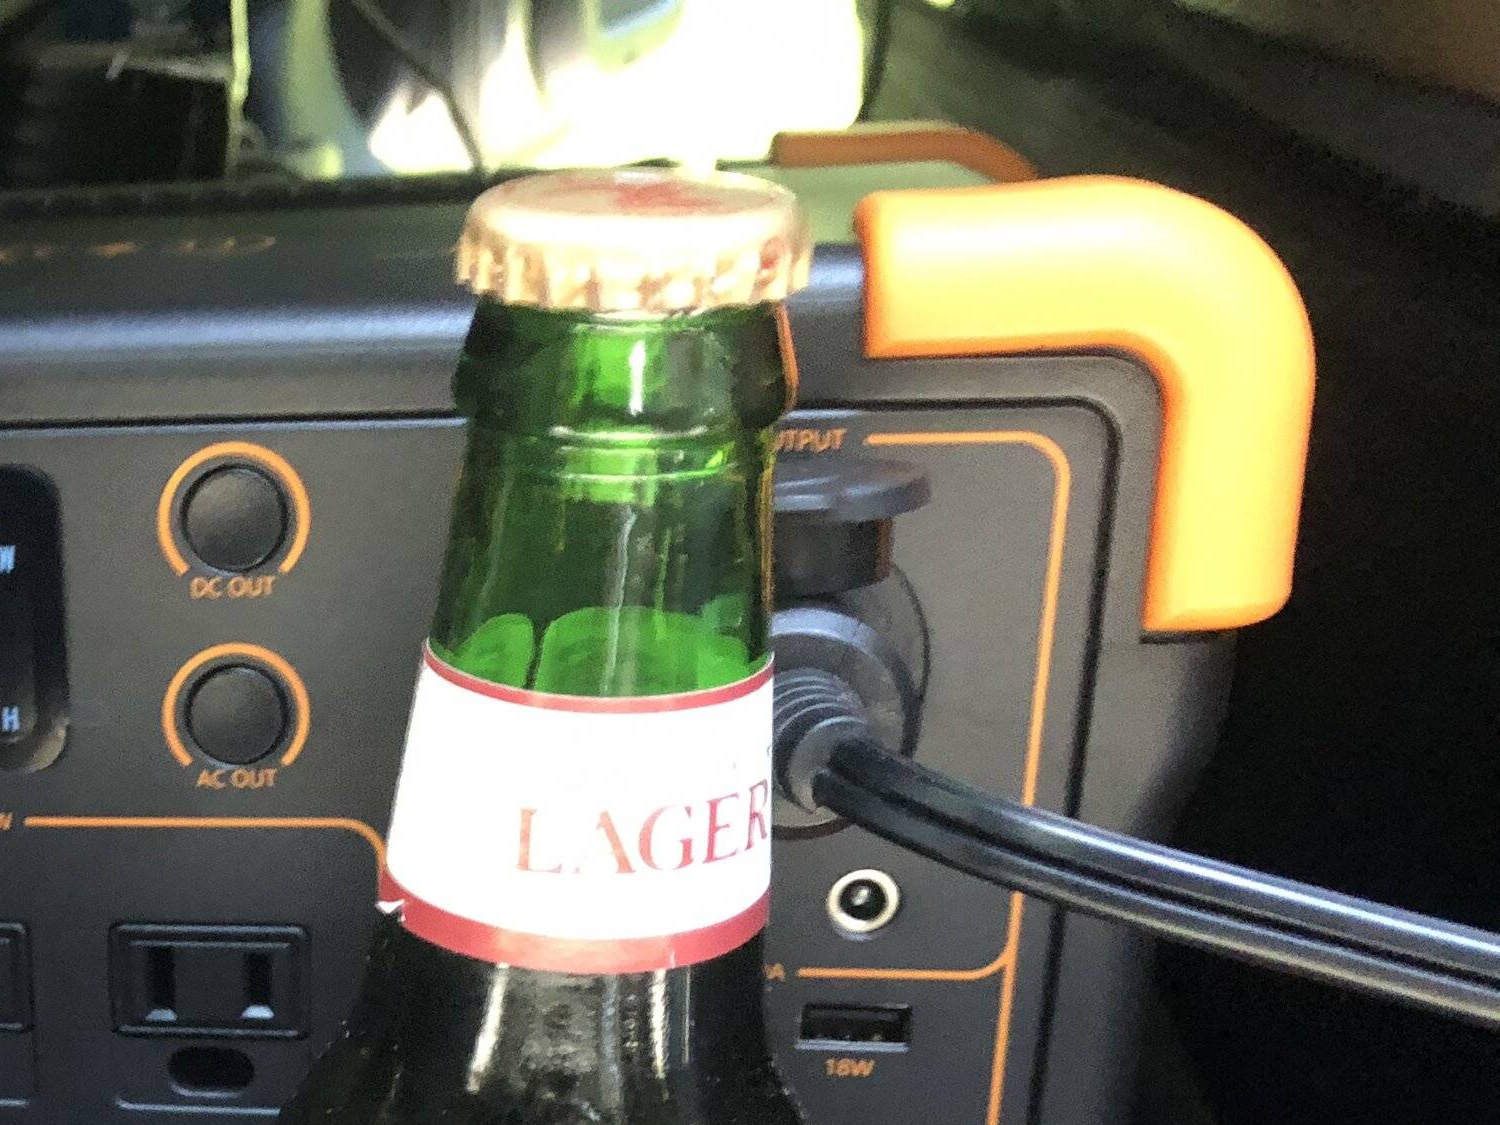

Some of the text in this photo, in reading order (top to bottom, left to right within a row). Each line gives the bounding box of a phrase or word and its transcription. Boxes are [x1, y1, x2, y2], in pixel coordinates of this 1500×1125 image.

[189, 575, 277, 600] DC OUT
[196, 768, 277, 791] AC OUT
[515, 779, 769, 875] LAGER
[825, 1057, 876, 1077] 18W
